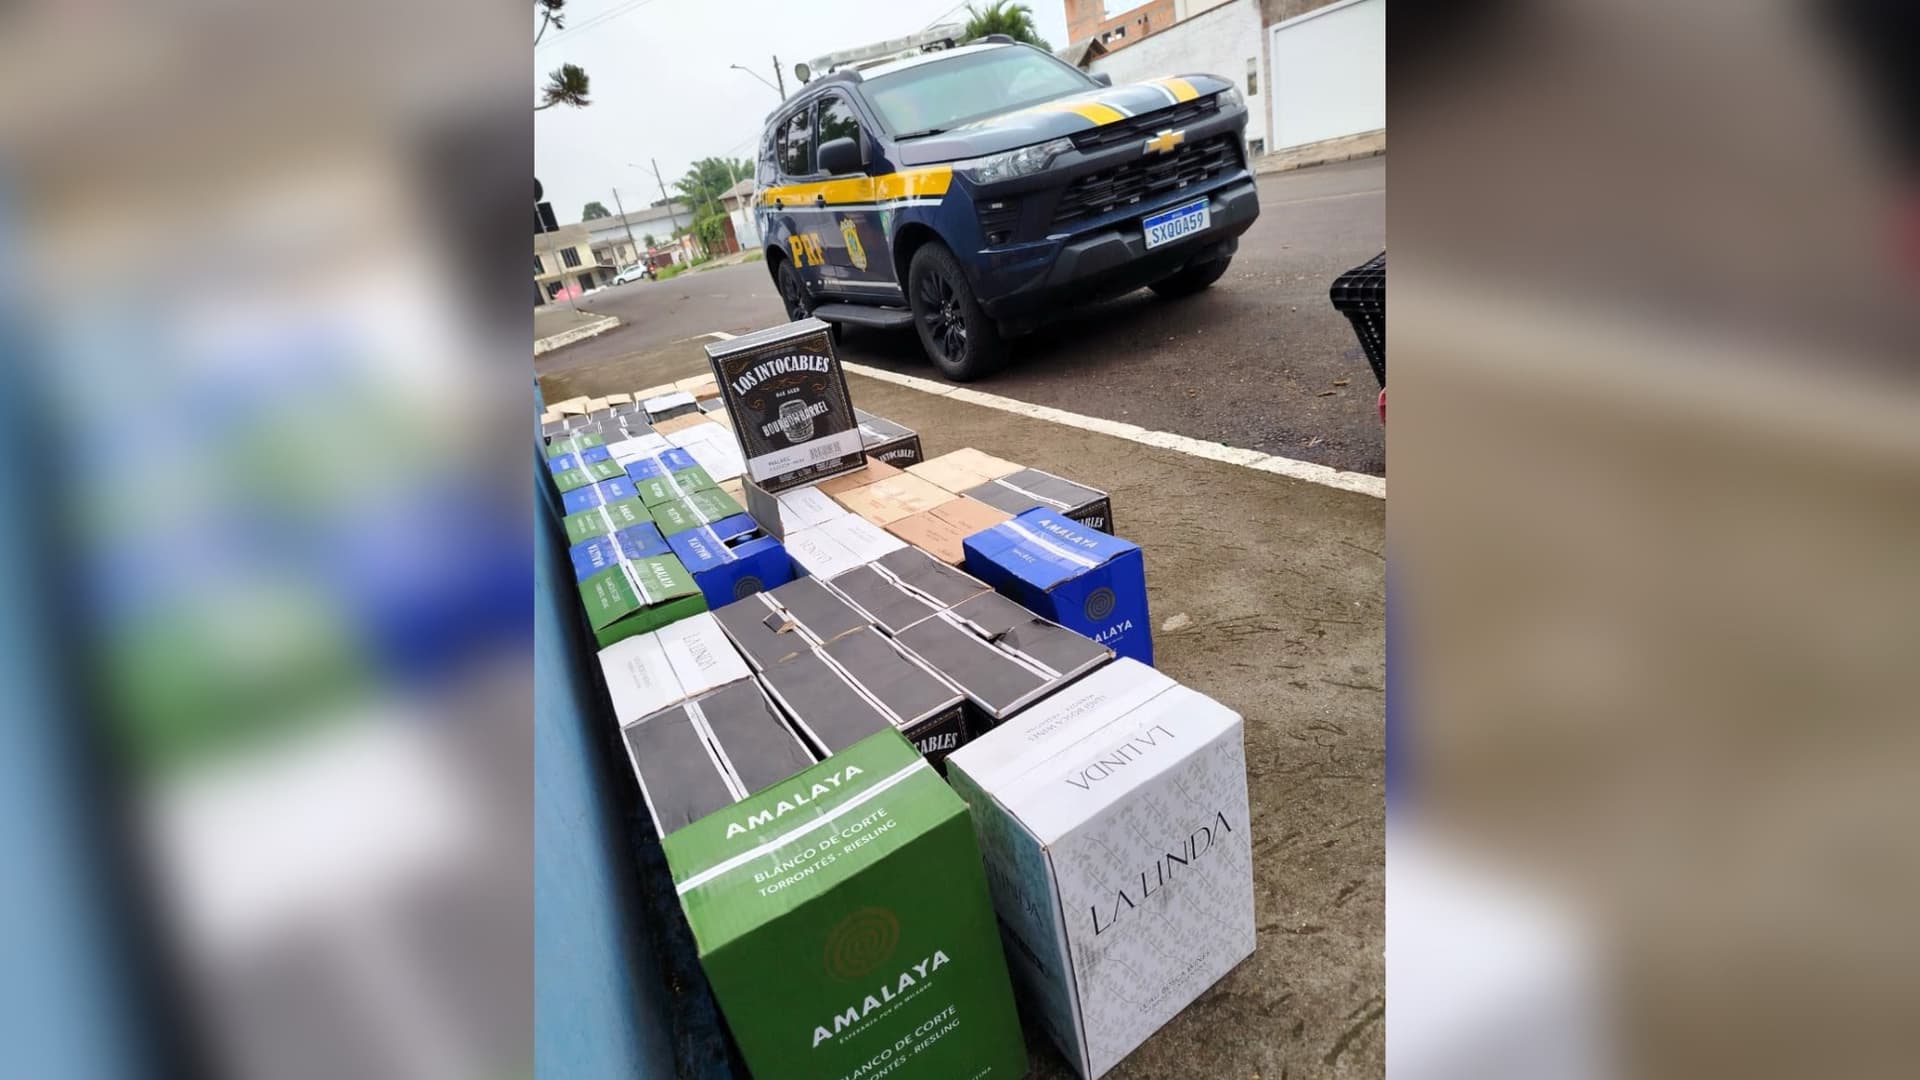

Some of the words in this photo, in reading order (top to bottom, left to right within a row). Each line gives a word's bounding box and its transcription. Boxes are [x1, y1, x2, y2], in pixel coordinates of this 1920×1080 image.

[787, 232, 825, 269] PRF
[732, 371, 758, 396] LOS
[753, 354, 830, 383] INTOCABLES
[761, 411, 801, 437] BOURBON
[799, 400, 829, 421] BARREL
[1039, 519, 1099, 548] AMALAYA
[1093, 619, 1133, 644] ALAYA
[1134, 724, 1176, 747] LA
[1065, 743, 1143, 791] LINDA
[725, 764, 864, 840] AMALAYA
[753, 848, 817, 884] BLANCO
[818, 834, 841, 851] DE
[841, 807, 888, 839] CORTE
[843, 818, 897, 855] RIESLING
[1089, 888, 1136, 937] LA
[1139, 809, 1233, 900] LINDA
[811, 949, 950, 1049] AMALAYA
[841, 1048, 892, 1080] LANCO
[894, 1033, 913, 1052] DE
[914, 1003, 957, 1038] CORTE
[869, 1054, 907, 1080] ONTÉS
[913, 1017, 961, 1054] RIESLING
